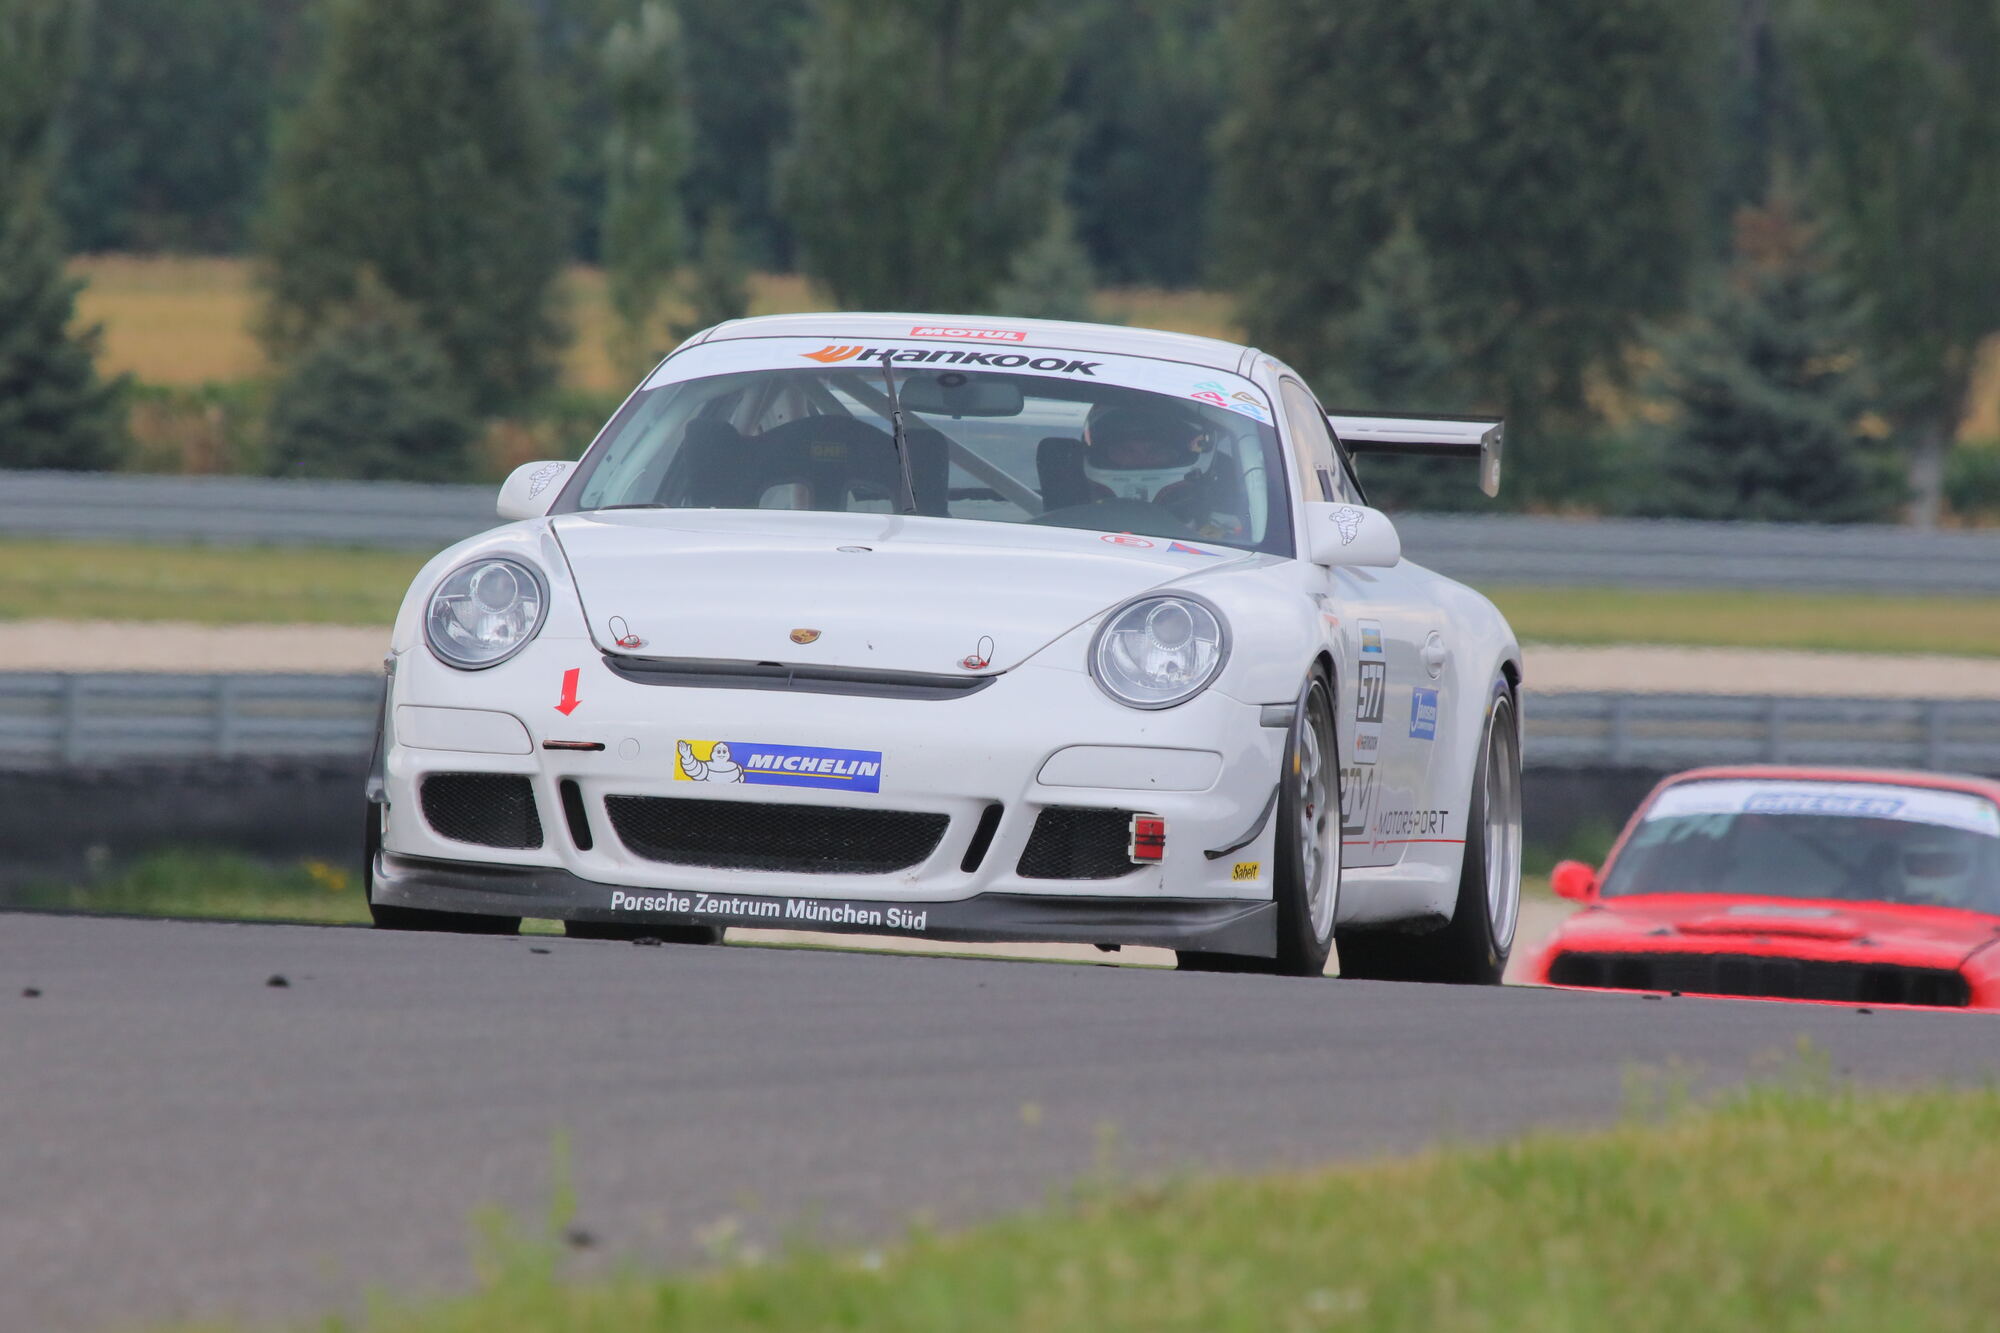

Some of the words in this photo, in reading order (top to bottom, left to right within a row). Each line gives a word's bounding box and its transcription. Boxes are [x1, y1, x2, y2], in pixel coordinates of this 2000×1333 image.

[915, 328, 1019, 340] MOTUL
[1357, 664, 1385, 719] 577
[746, 753, 880, 777] MICHELIN
[1379, 810, 1449, 835] MOTORSPORT
[1233, 863, 1258, 880] Sabelt
[610, 891, 691, 913] Porsche
[694, 893, 781, 918] Zentrum
[785, 899, 882, 926] München
[886, 907, 927, 931] Süd
